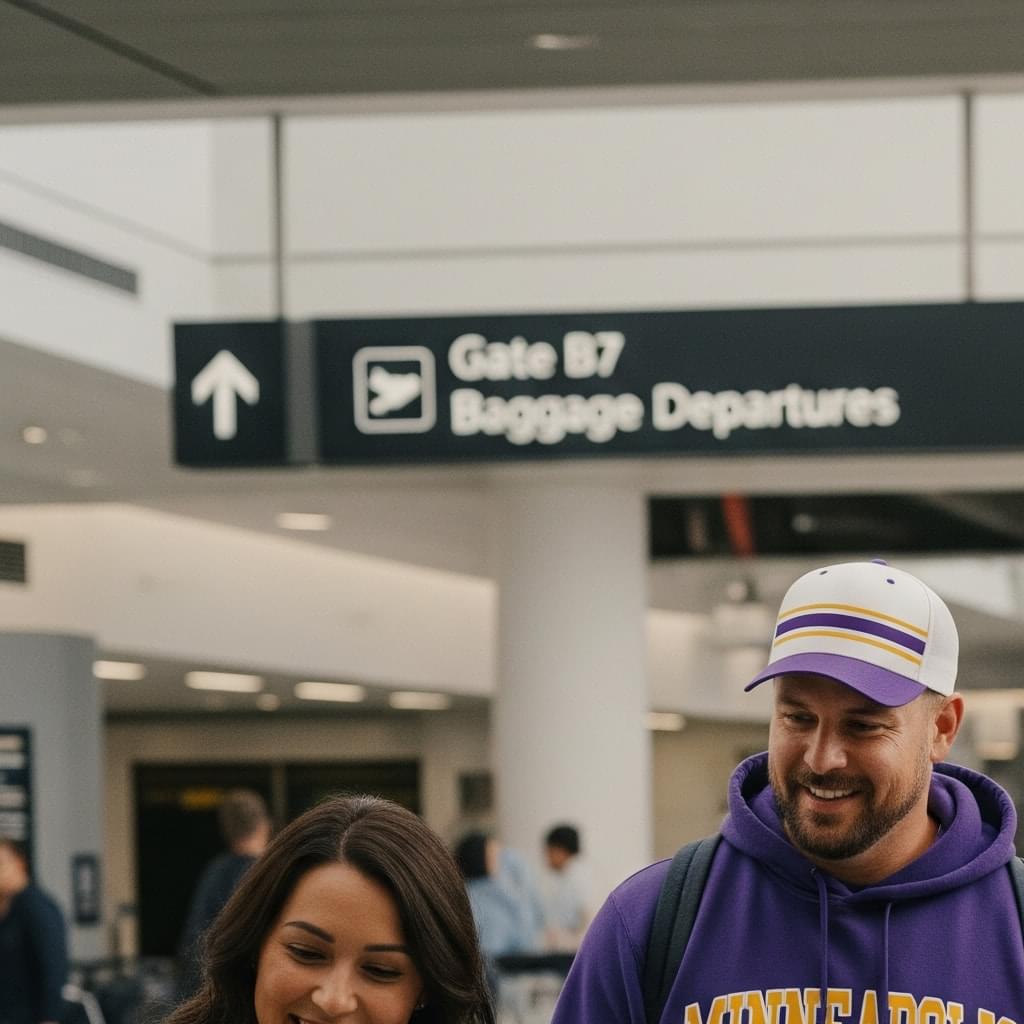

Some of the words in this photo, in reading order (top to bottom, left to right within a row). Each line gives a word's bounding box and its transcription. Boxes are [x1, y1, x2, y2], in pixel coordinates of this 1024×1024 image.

[449, 334, 557, 381] Gate
[564, 332, 625, 378] B7
[451, 389, 644, 444] Baggage
[652, 383, 900, 439] Departures
